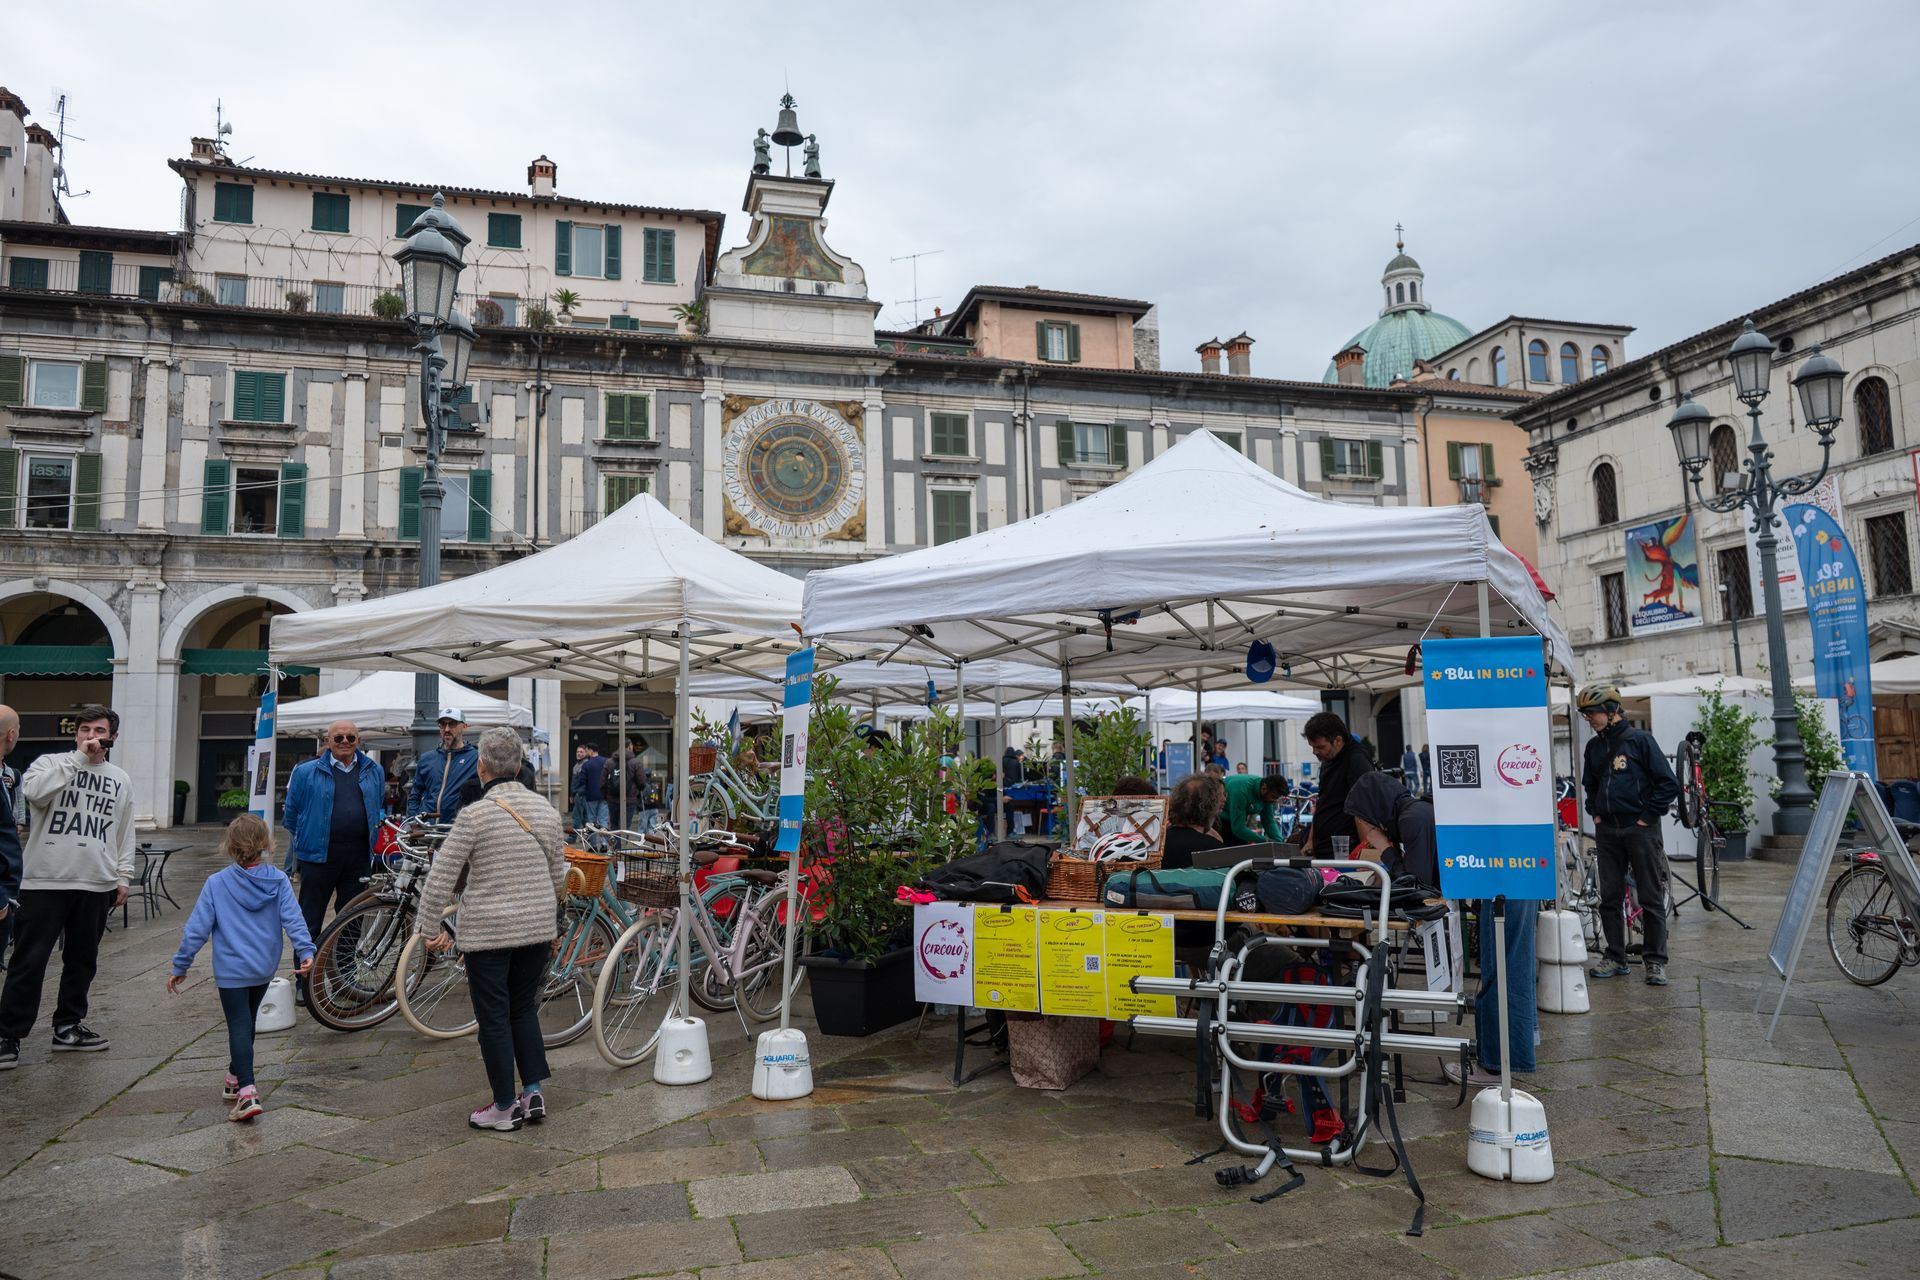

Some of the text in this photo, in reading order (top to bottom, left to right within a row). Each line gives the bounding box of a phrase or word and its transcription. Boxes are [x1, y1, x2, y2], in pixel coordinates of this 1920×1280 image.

[1635, 617, 1651, 626] DEGLI
[1651, 613, 1674, 623] OPPOSTI
[1445, 667, 1523, 680] Blu IN BICI
[609, 713, 635, 723] faoli
[1501, 760, 1537, 770] CIRCOLO
[60, 791, 116, 816] IN THE
[48, 811, 114, 843] BANK
[1455, 855, 1537, 868] Blu IN BICI
[925, 943, 963, 956] CIRCOLO
